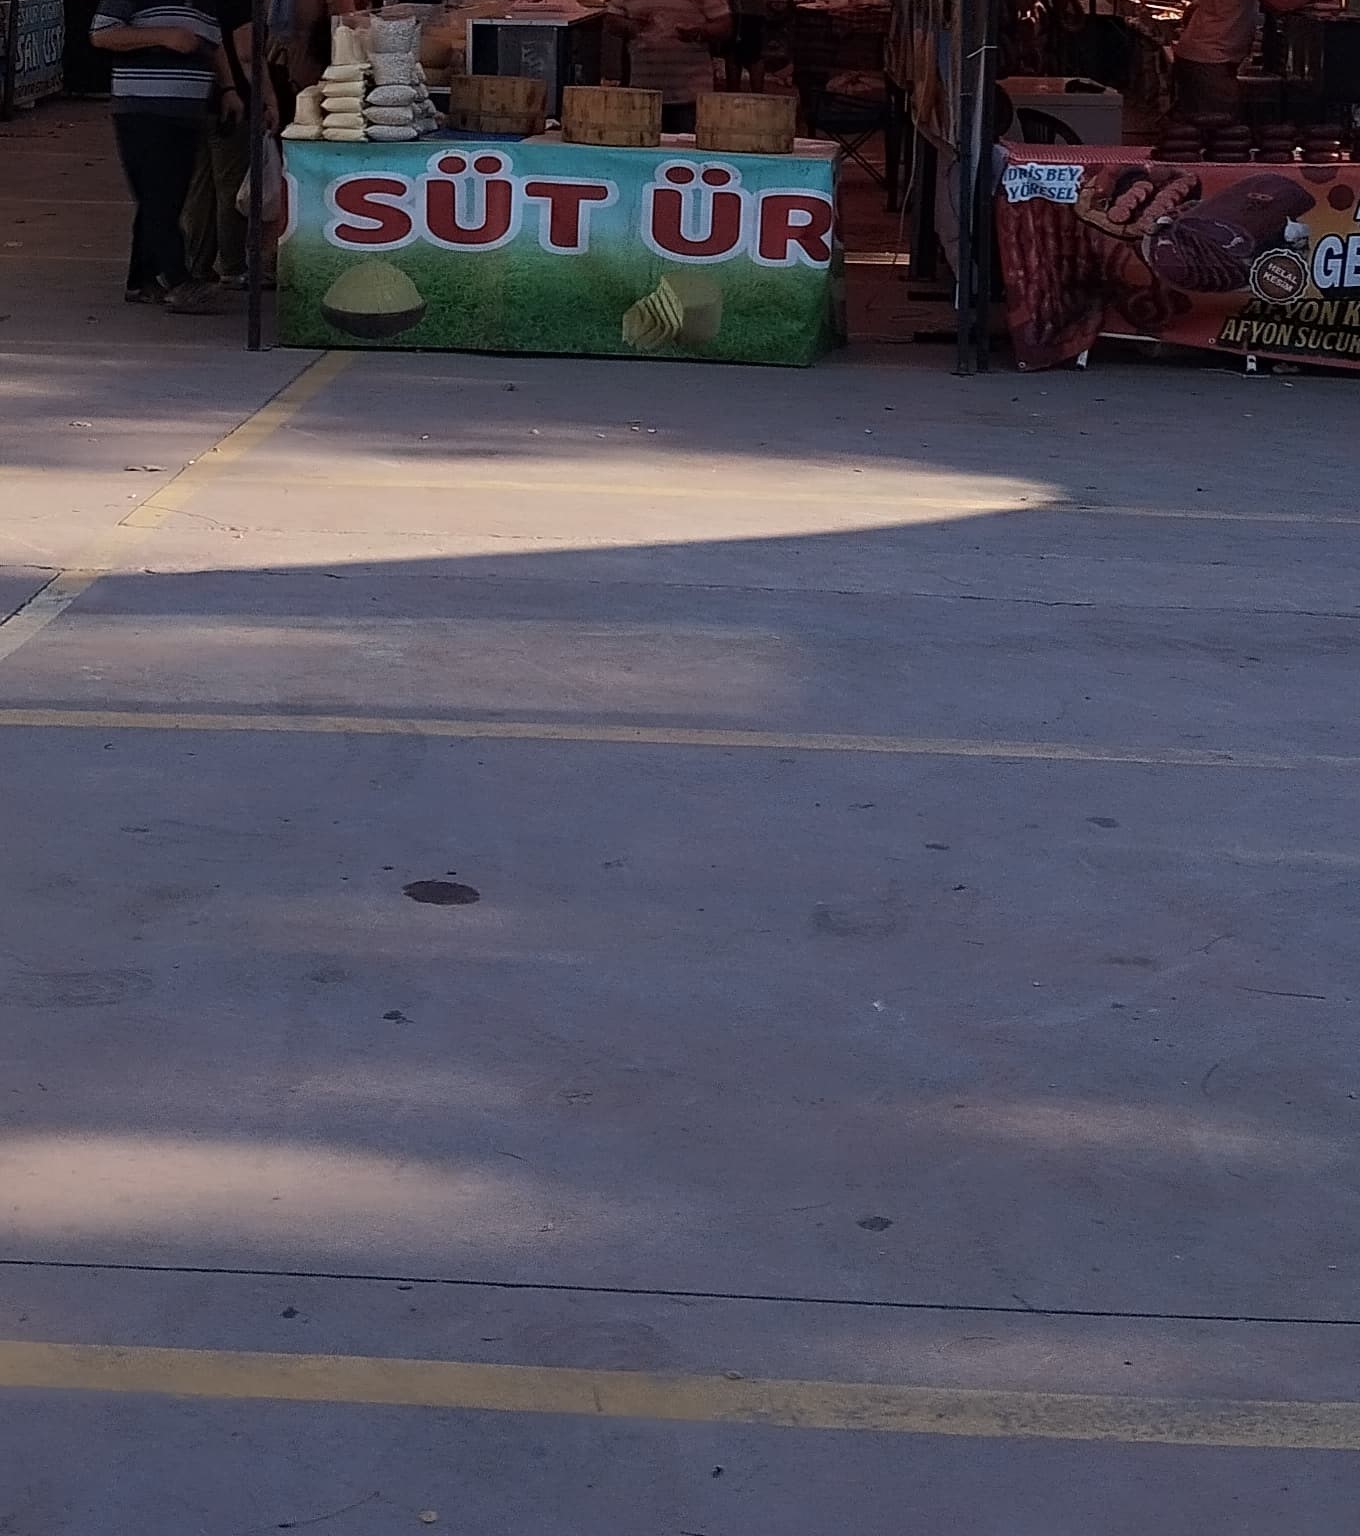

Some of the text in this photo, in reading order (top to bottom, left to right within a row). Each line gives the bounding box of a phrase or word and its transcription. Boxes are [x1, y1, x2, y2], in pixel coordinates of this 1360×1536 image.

[1047, 168, 1080, 181] BEY
[1009, 182, 1075, 200] YÖRESEL
[330, 153, 831, 264] SÜT ÜR
[1221, 319, 1293, 347] AFYON
